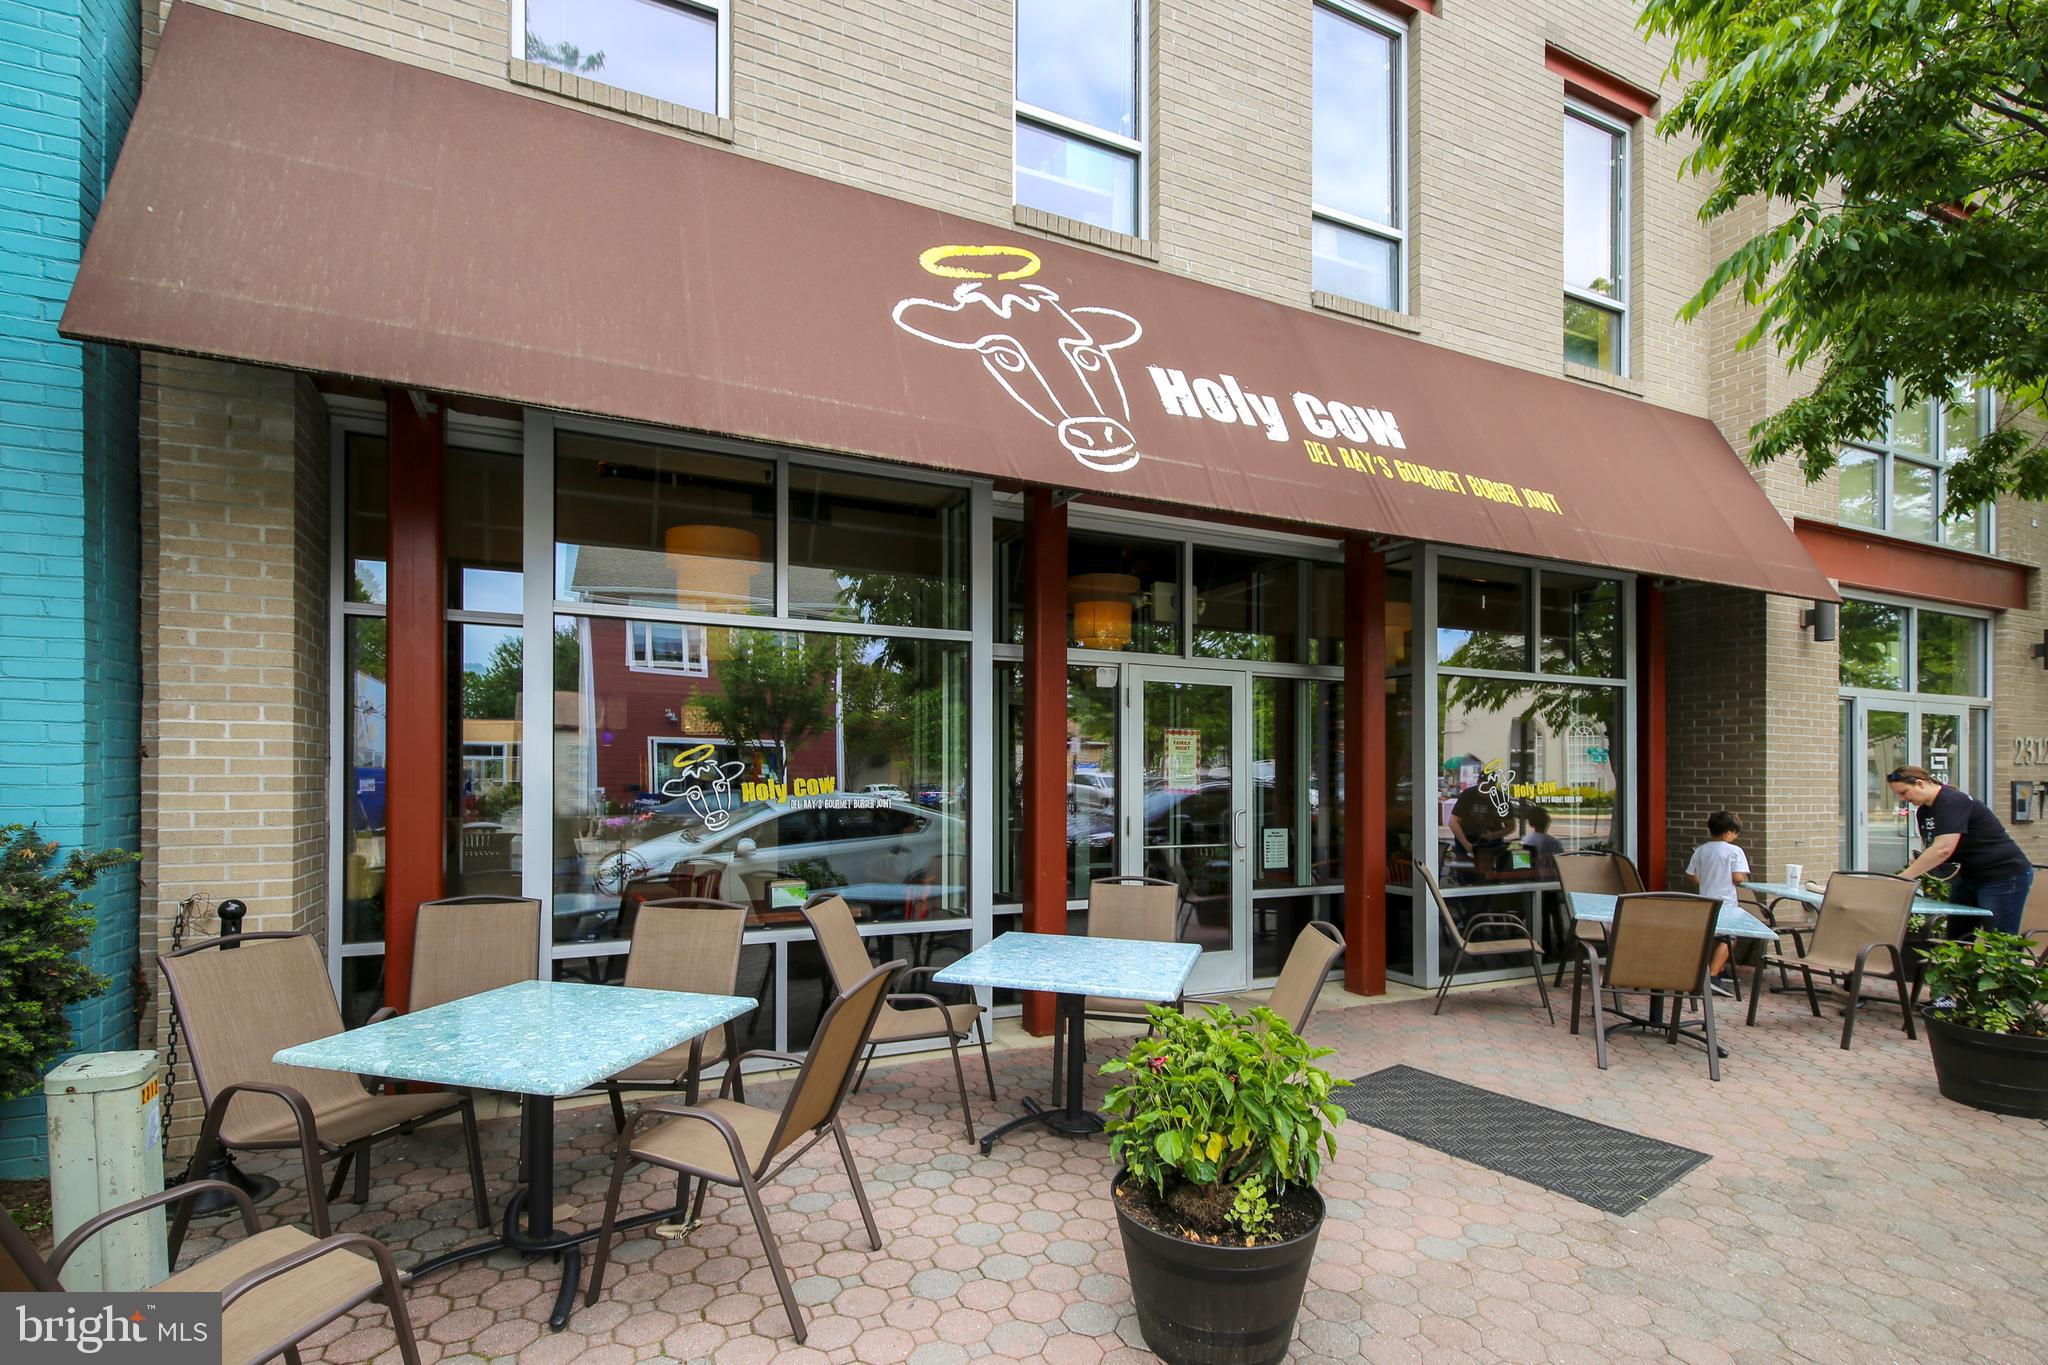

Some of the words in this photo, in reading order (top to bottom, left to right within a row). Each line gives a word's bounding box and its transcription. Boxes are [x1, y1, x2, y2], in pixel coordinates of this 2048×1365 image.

[1147, 365, 1289, 442] Holy
[1303, 439, 1338, 467] DEL
[1337, 447, 1394, 479] RAY'S
[1393, 459, 1467, 495] GOURMET
[1465, 474, 1524, 507] BURGER
[1520, 488, 1564, 516] JOINT
[741, 778, 788, 804] Holy
[1513, 781, 1535, 800] Holy
[824, 798, 851, 810] GOURMET
[875, 798, 892, 809] JOINT
